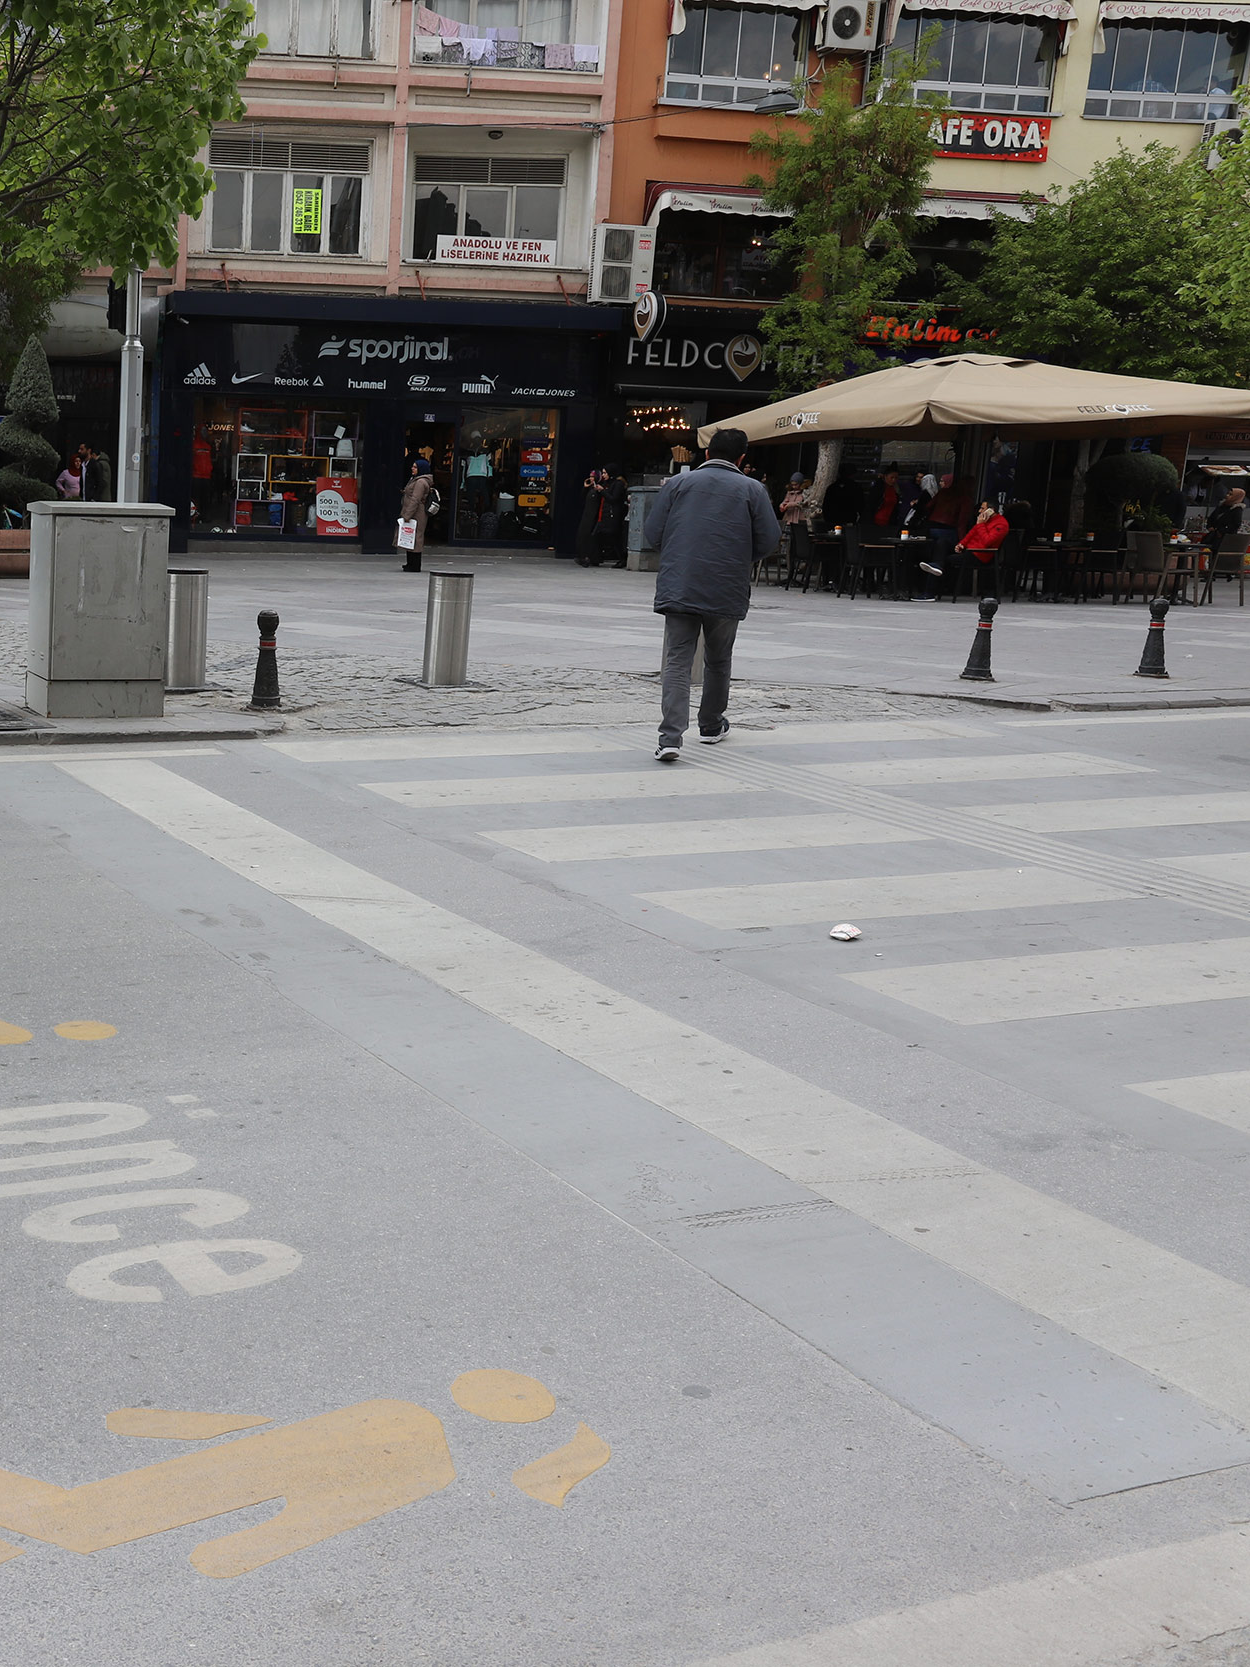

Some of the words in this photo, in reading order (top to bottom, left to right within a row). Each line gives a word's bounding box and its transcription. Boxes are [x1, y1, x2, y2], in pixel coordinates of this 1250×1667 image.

[928, 117, 975, 146] AFE
[983, 119, 1042, 149] ORA
[452, 238, 501, 249] ANADOLU
[505, 240, 519, 250] VE
[522, 241, 542, 251] FEN
[502, 251, 550, 263] HAZIRLIK
[347, 335, 449, 365] sporjinal
[183, 376, 217, 385] adidas
[274, 377, 309, 386] Reebok
[347, 378, 386, 390] hummel
[462, 382, 491, 394] PUMA
[511, 387, 536, 395] JACK
[545, 389, 576, 397] JONES
